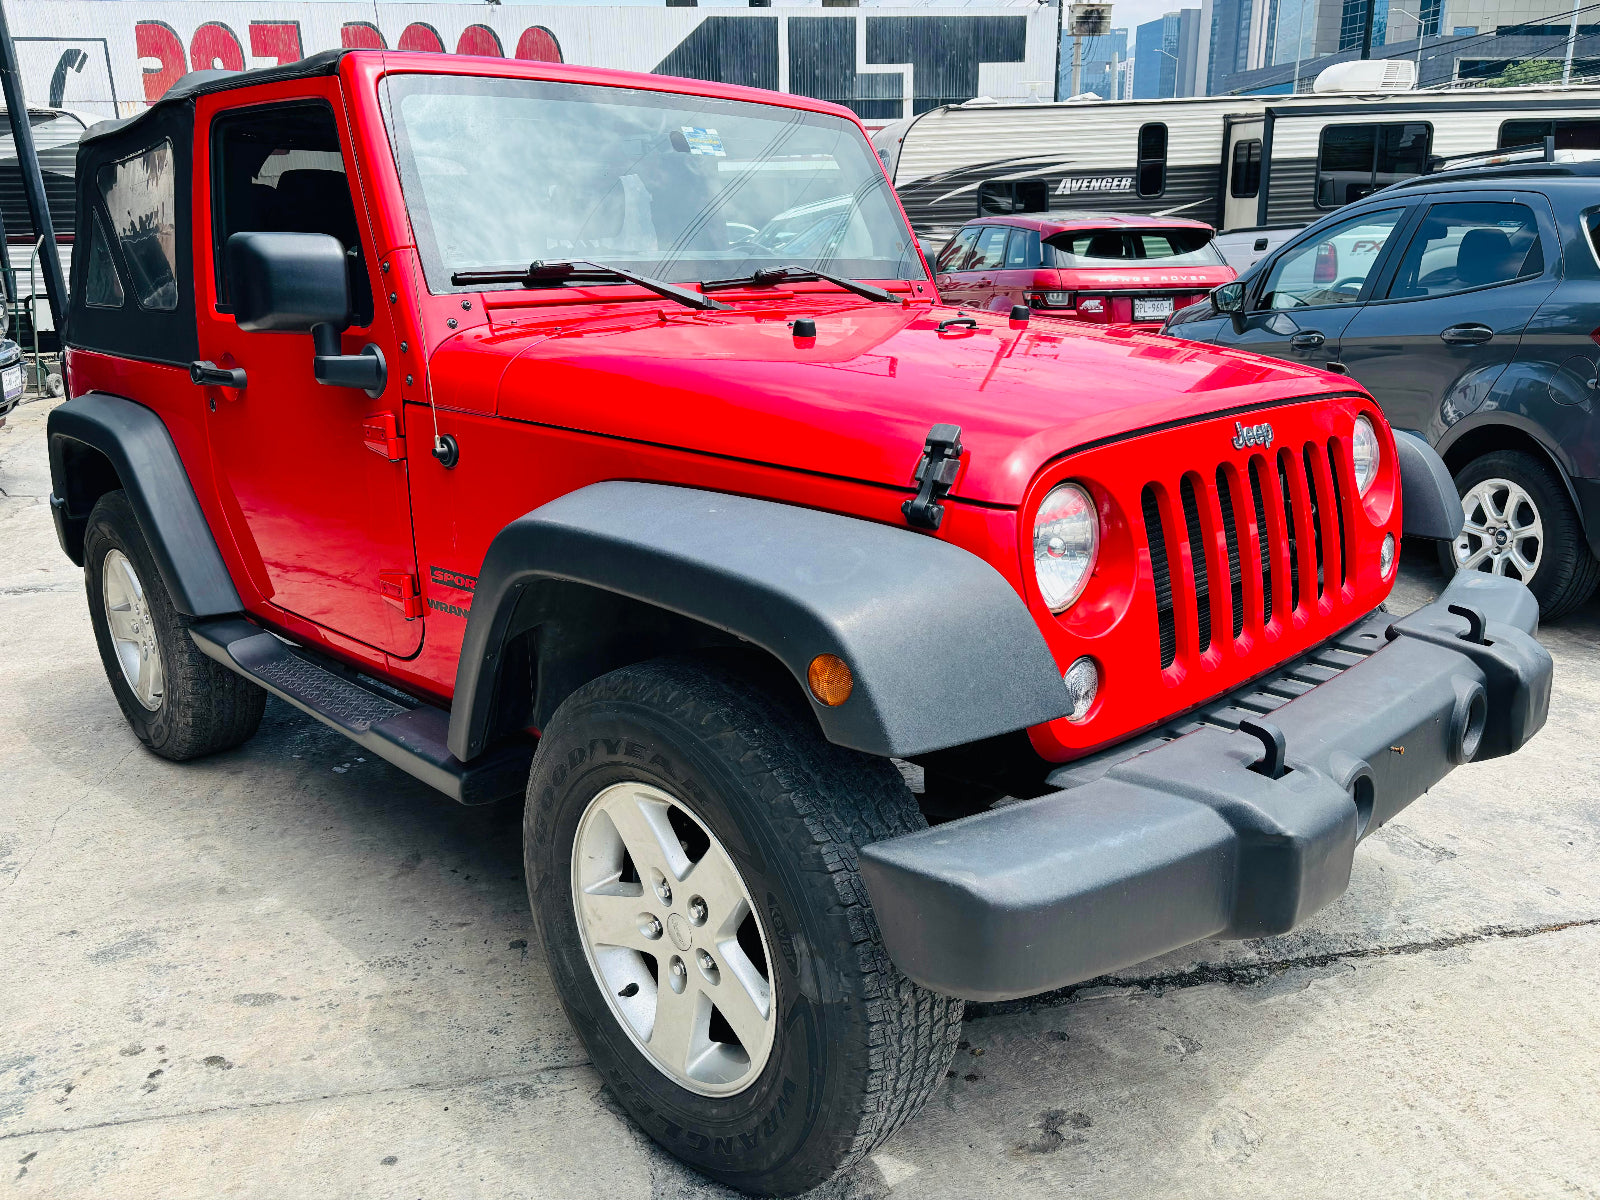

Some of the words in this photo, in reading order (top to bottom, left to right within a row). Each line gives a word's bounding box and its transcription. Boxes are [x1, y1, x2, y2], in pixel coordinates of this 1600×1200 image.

[1054, 177, 1133, 195] AVENGER
[1351, 240, 1386, 253] FX
[1231, 421, 1274, 450] Jeep
[431, 570, 478, 590] SPOR
[426, 597, 470, 619] WRAN
